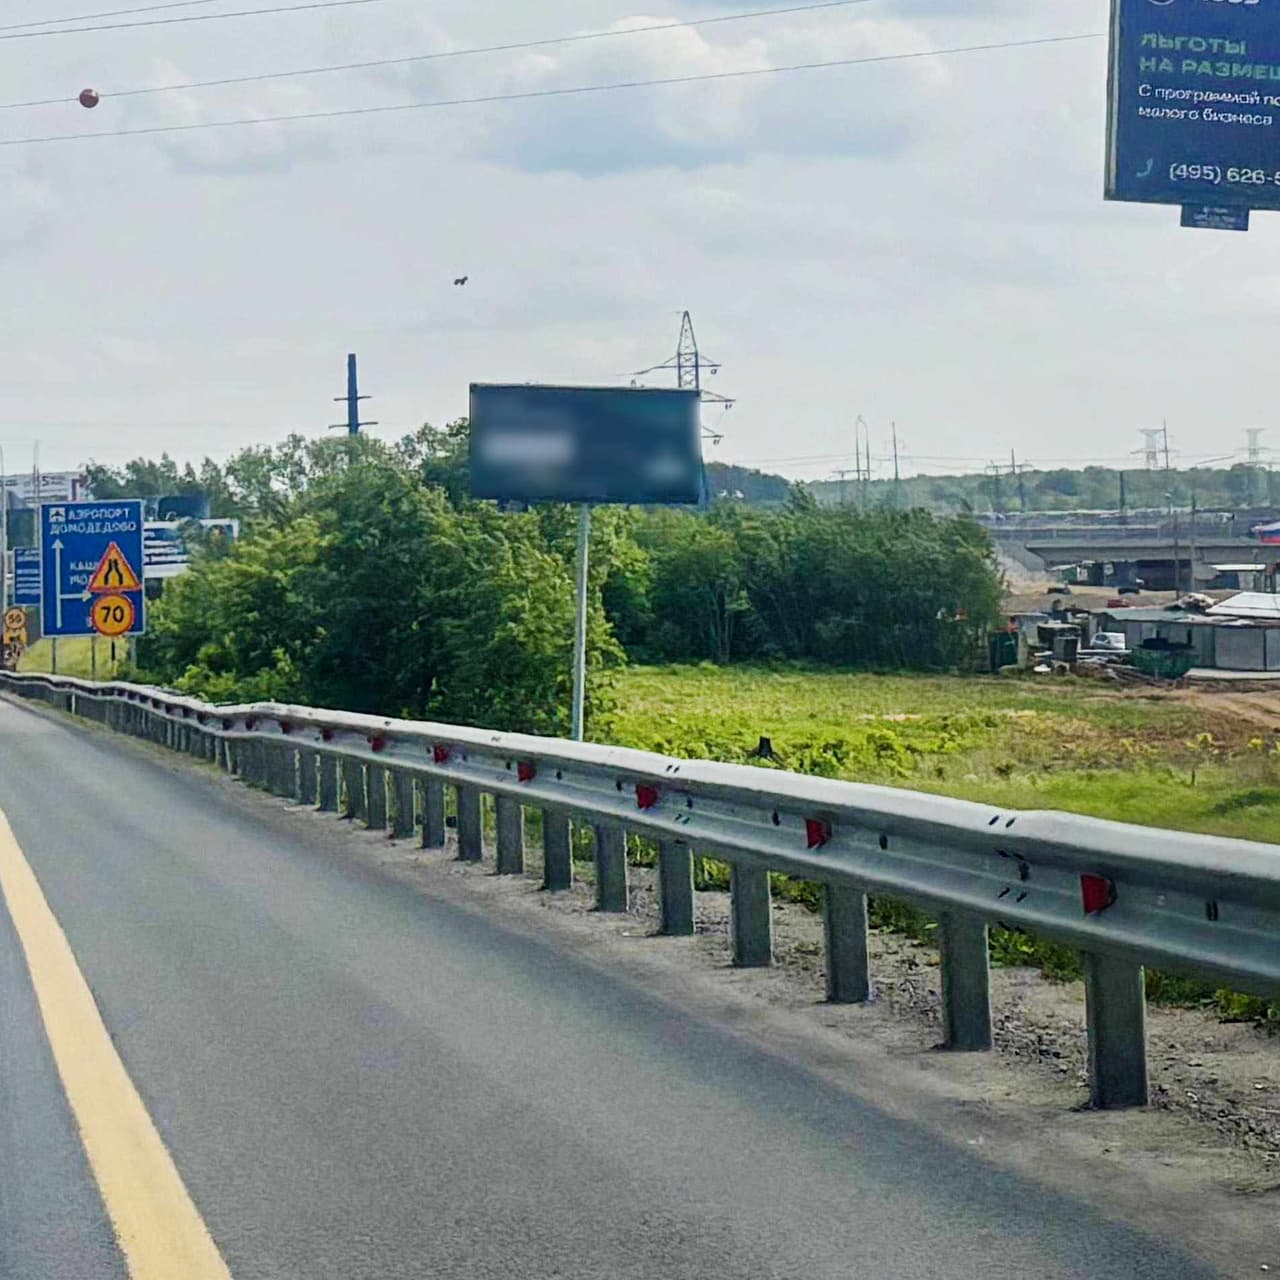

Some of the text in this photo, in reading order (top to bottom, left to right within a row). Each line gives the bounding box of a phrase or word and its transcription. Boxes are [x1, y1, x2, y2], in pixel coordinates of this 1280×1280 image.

[1141, 32, 1247, 55] ЛЬГОТЫ
[1139, 56, 1173, 73] НА
[1139, 83, 1152, 96] С
[1169, 162, 1221, 185] (495)
[101, 605, 124, 623] 70
